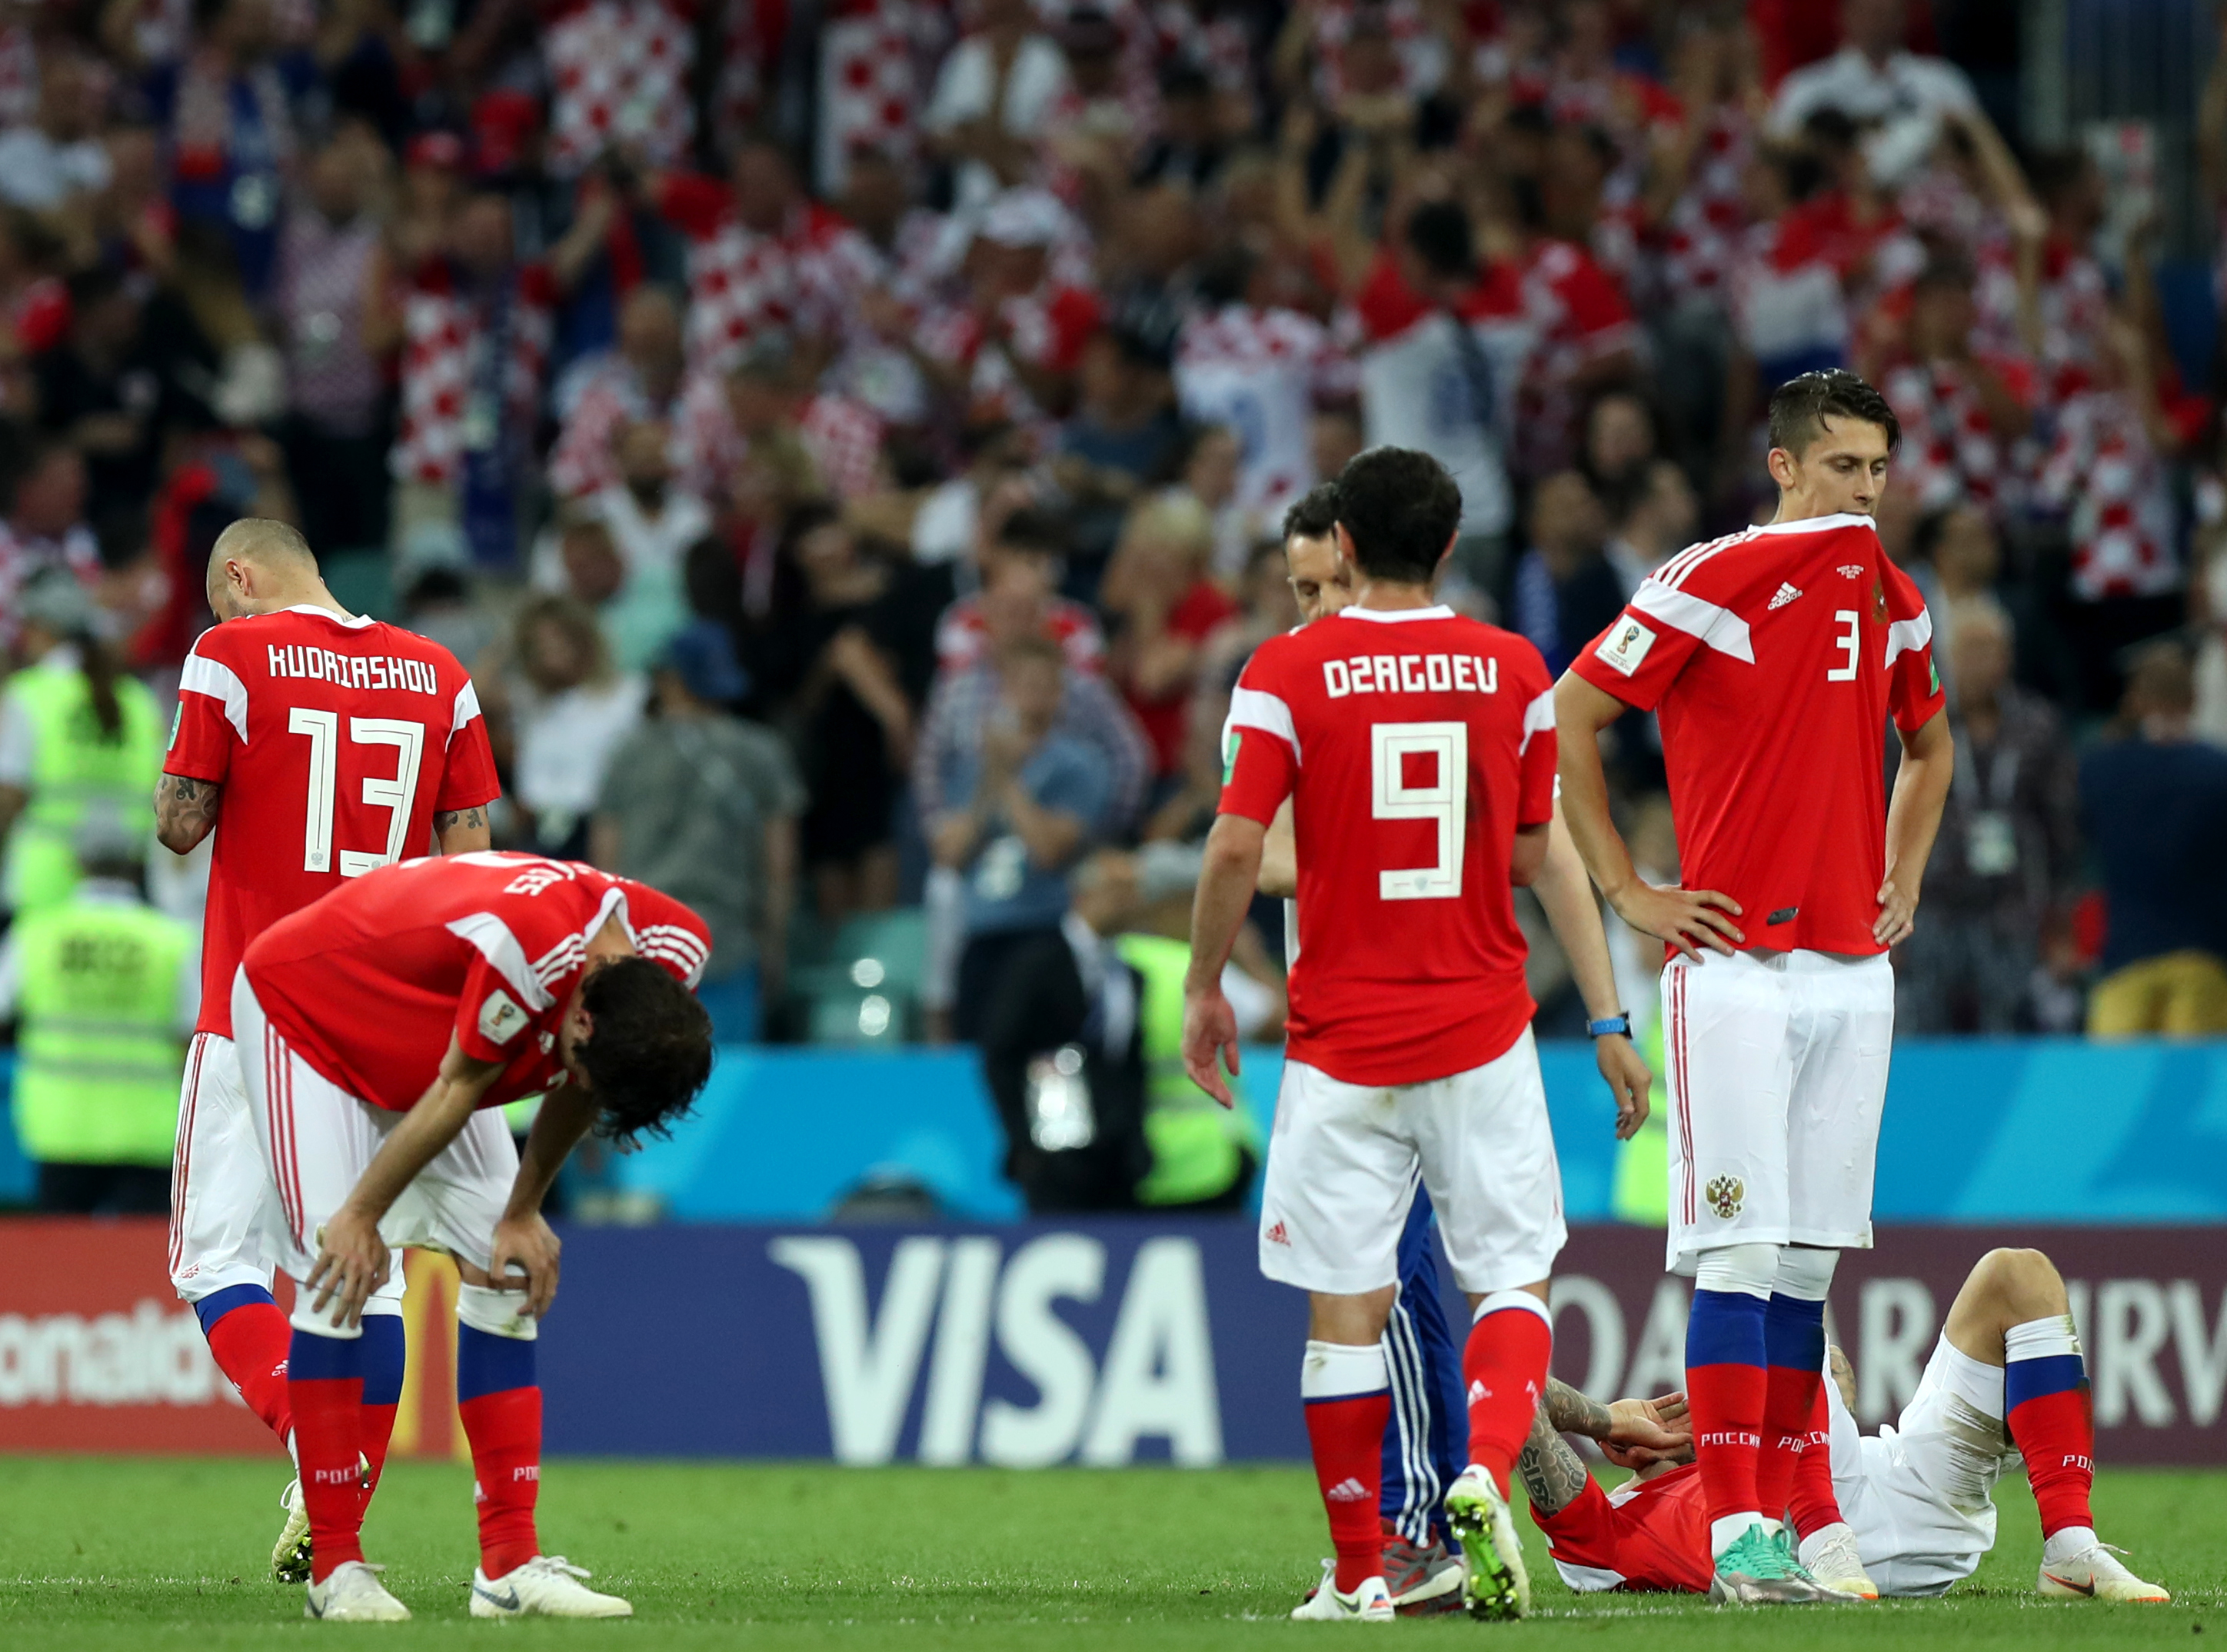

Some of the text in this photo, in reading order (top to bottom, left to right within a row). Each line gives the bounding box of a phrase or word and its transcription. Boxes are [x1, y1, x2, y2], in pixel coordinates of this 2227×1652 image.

[1767, 589, 1803, 611] adidas
[267, 644, 438, 696] KUDRIASHOV
[1323, 654, 1499, 698] DZAGOEV
[1827, 610, 1859, 681] 3
[288, 707, 424, 878] 13
[1370, 721, 1468, 901] 9
[767, 1231, 1227, 1470] VISA
[1701, 1431, 1761, 1449] РОССИЯ
